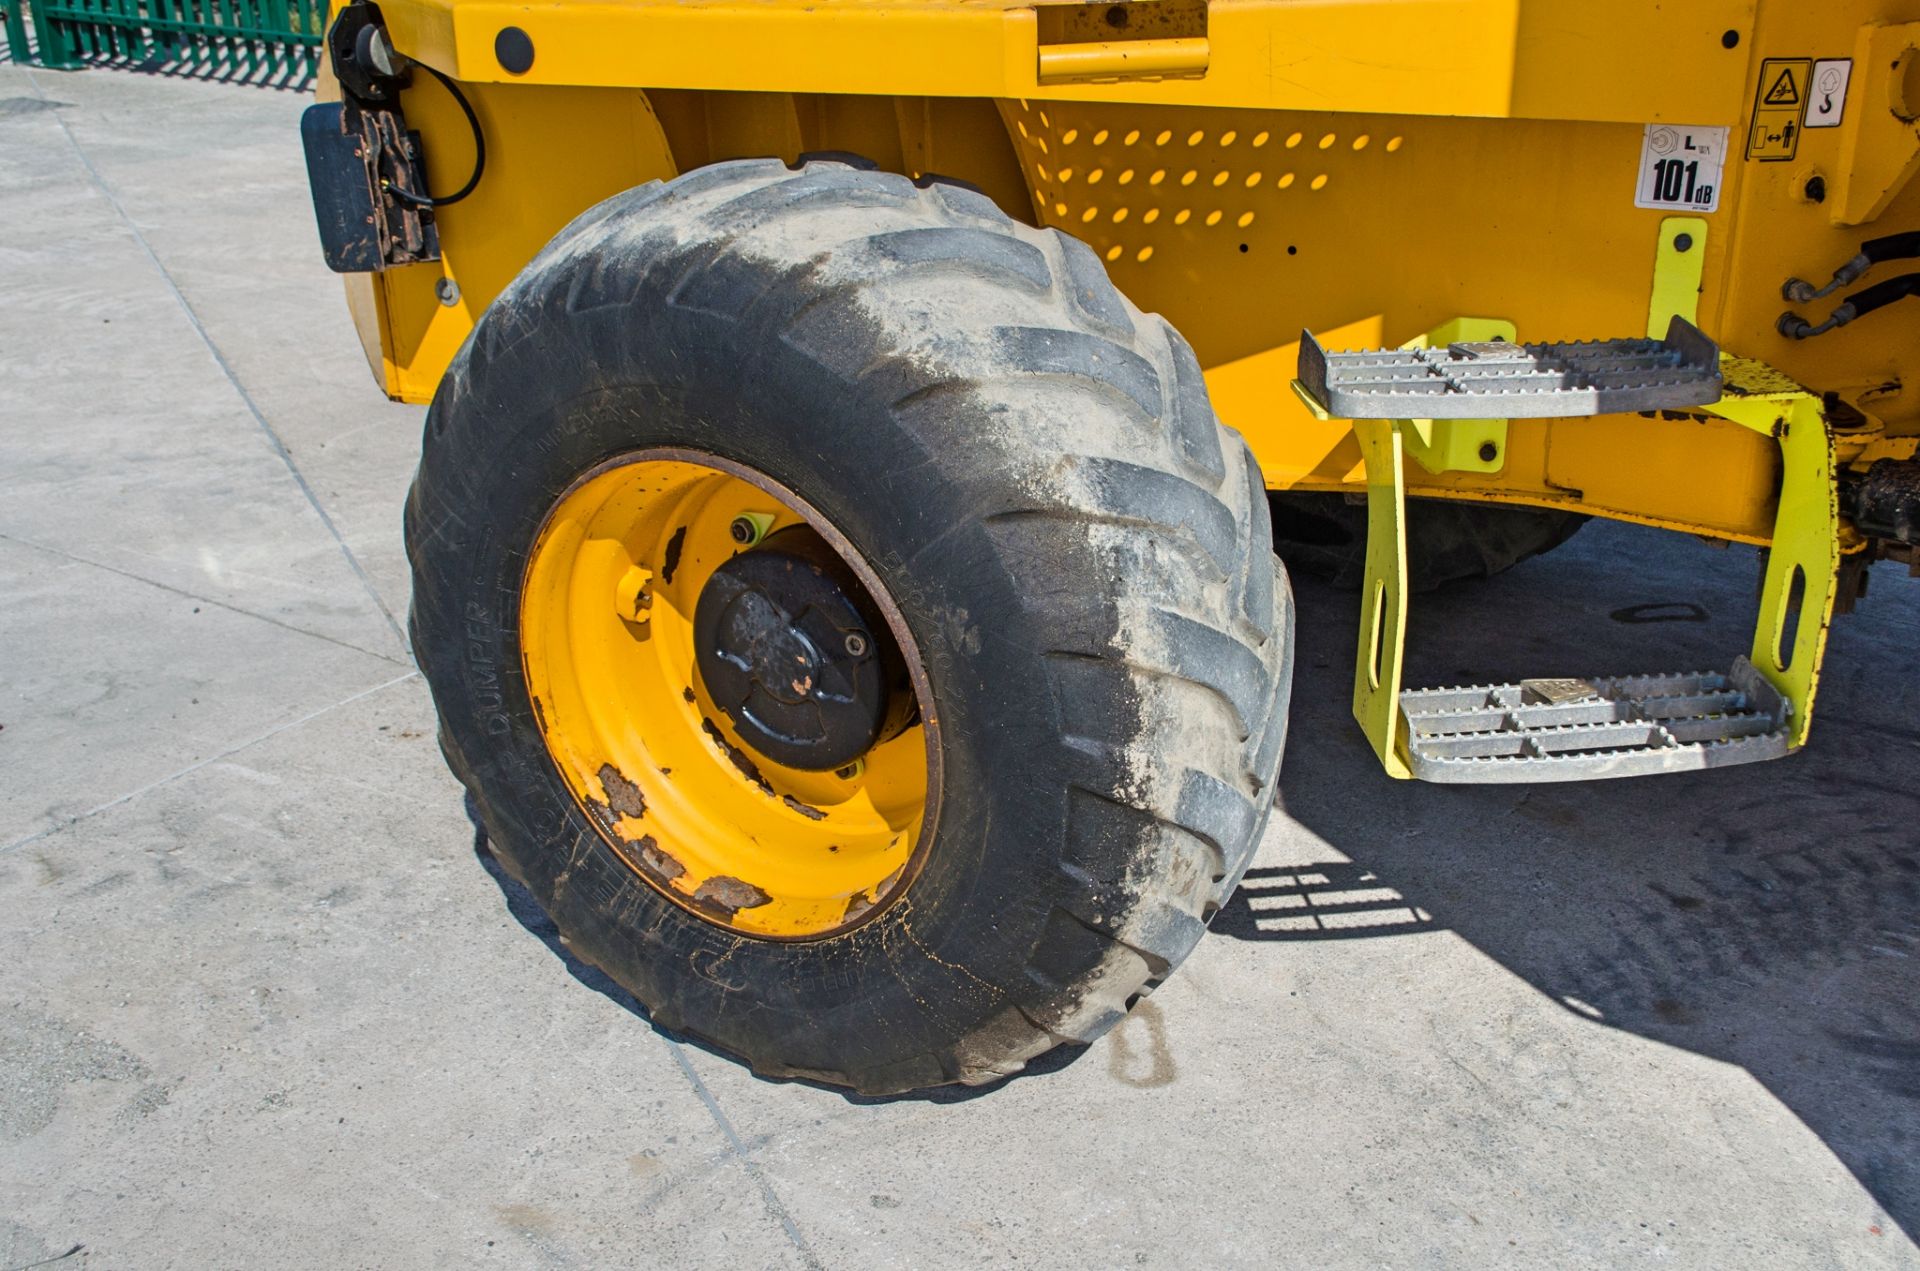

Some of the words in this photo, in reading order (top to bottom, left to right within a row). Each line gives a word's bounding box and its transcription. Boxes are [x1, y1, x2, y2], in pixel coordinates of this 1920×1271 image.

[1684, 135, 1697, 151] L
[1652, 158, 1699, 203] 101
[1694, 184, 1713, 204] dB
[464, 603, 510, 737] DUMPER
